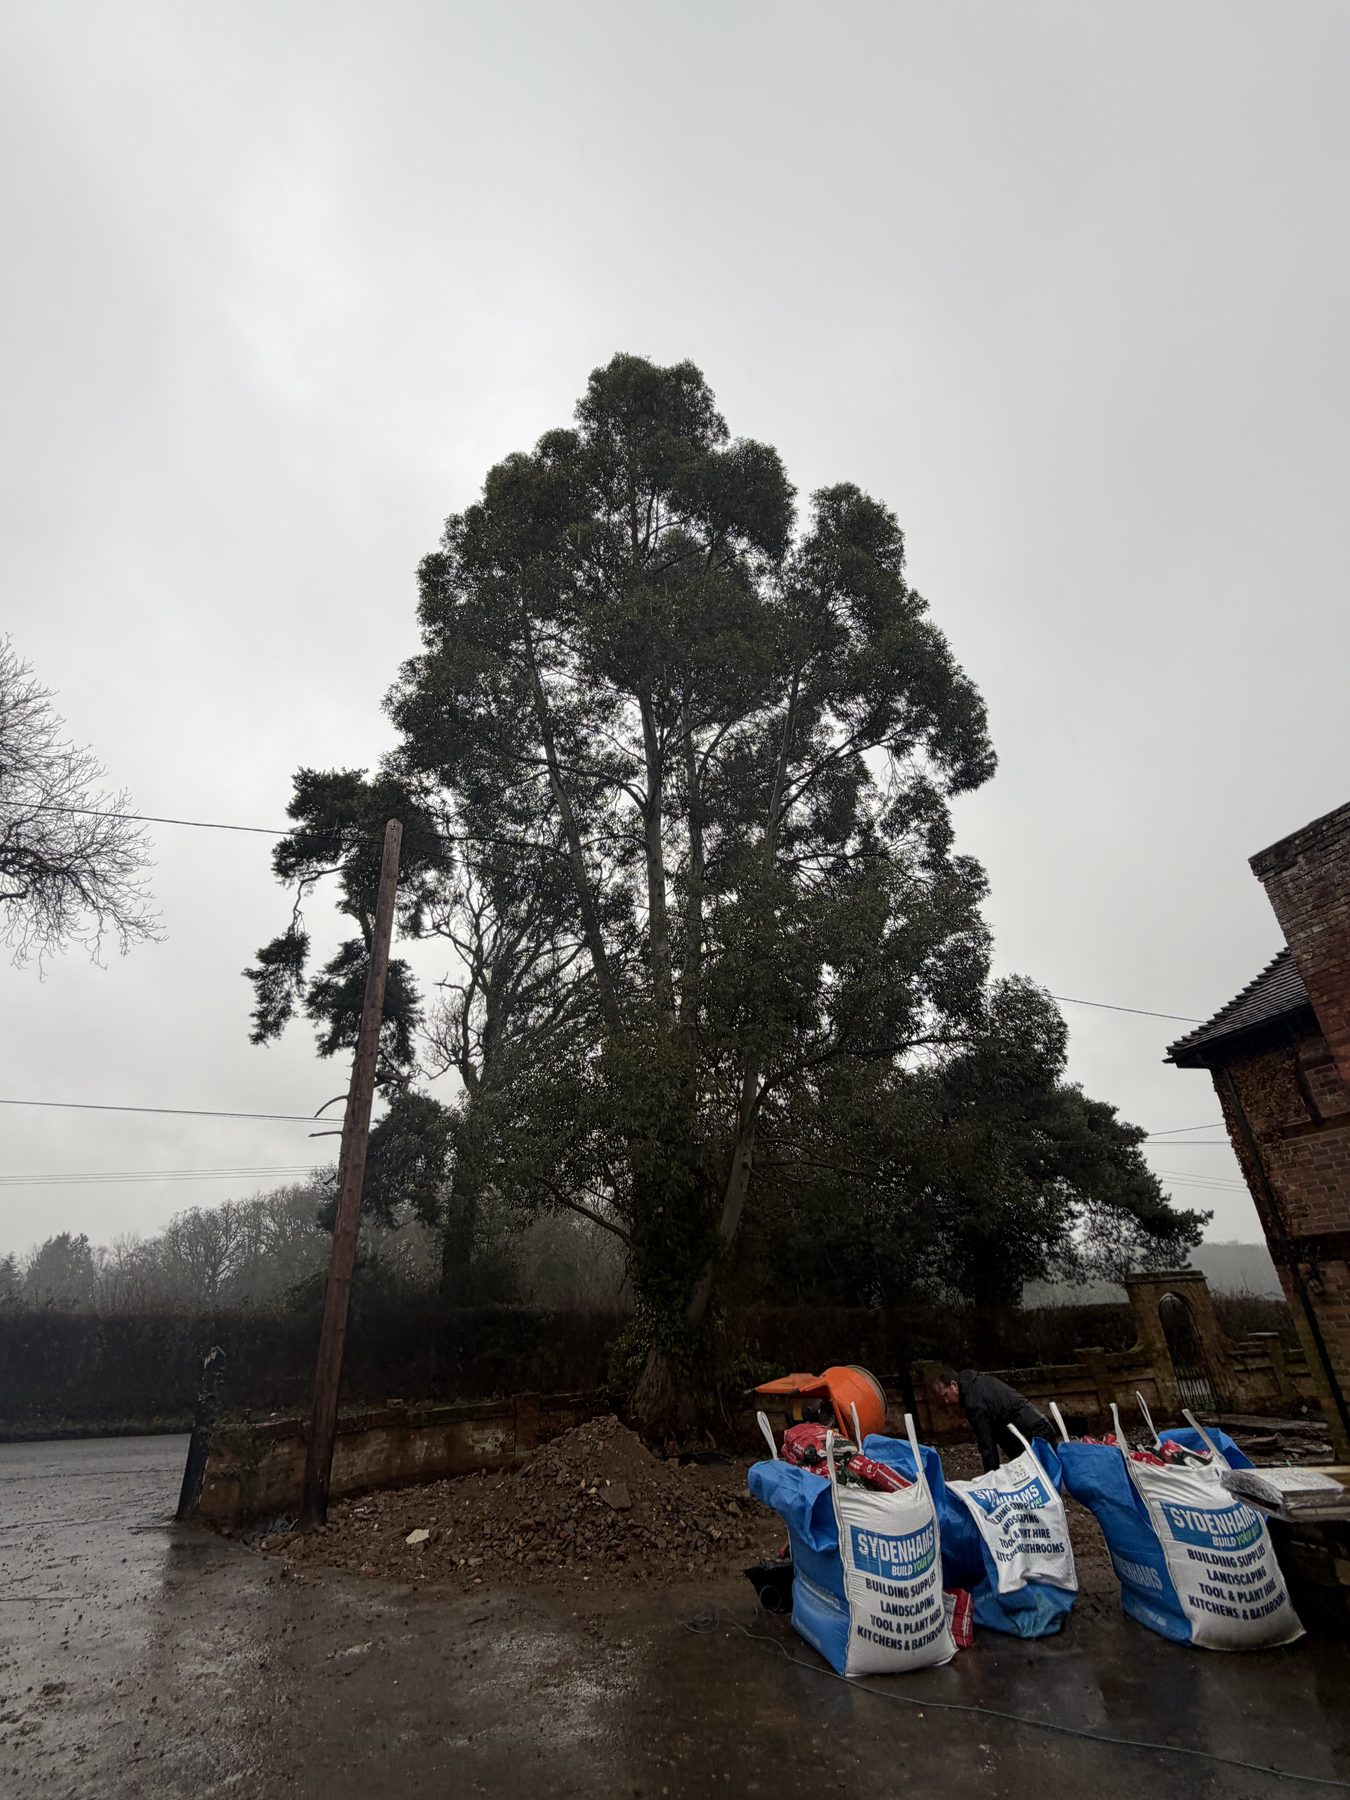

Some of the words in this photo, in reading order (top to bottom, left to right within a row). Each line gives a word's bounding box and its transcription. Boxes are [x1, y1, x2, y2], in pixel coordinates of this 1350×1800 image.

[1169, 1504, 1257, 1536] SYDENHAMS
[857, 1525, 935, 1564] SYDENHAMS
[1032, 1529, 1051, 1538] HIRE
[1212, 1535, 1237, 1548] BUILD
[1187, 1548, 1238, 1569] BUILDING
[1237, 1543, 1266, 1568] SUPPLIES
[891, 1564, 913, 1577] BUILD
[1206, 1565, 1267, 1586] LANDSCAPING
[865, 1577, 910, 1599] BUILDING
[910, 1569, 937, 1598] SUPPLIES
[1198, 1582, 1227, 1600] TOOL
[1227, 1590, 1236, 1603] &
[1236, 1588, 1264, 1604] PLANT
[1263, 1576, 1277, 1597] HIRE
[880, 1594, 935, 1617] LANDSCAPING
[1188, 1594, 1239, 1619] KITCHENS
[1242, 1609, 1249, 1620] &
[870, 1614, 894, 1634] TOOL
[896, 1621, 903, 1634] &
[904, 1617, 929, 1635] PLANT
[929, 1605, 942, 1626] HIRE
[857, 1625, 903, 1650] KITCHENS
[904, 1640, 910, 1651] &
